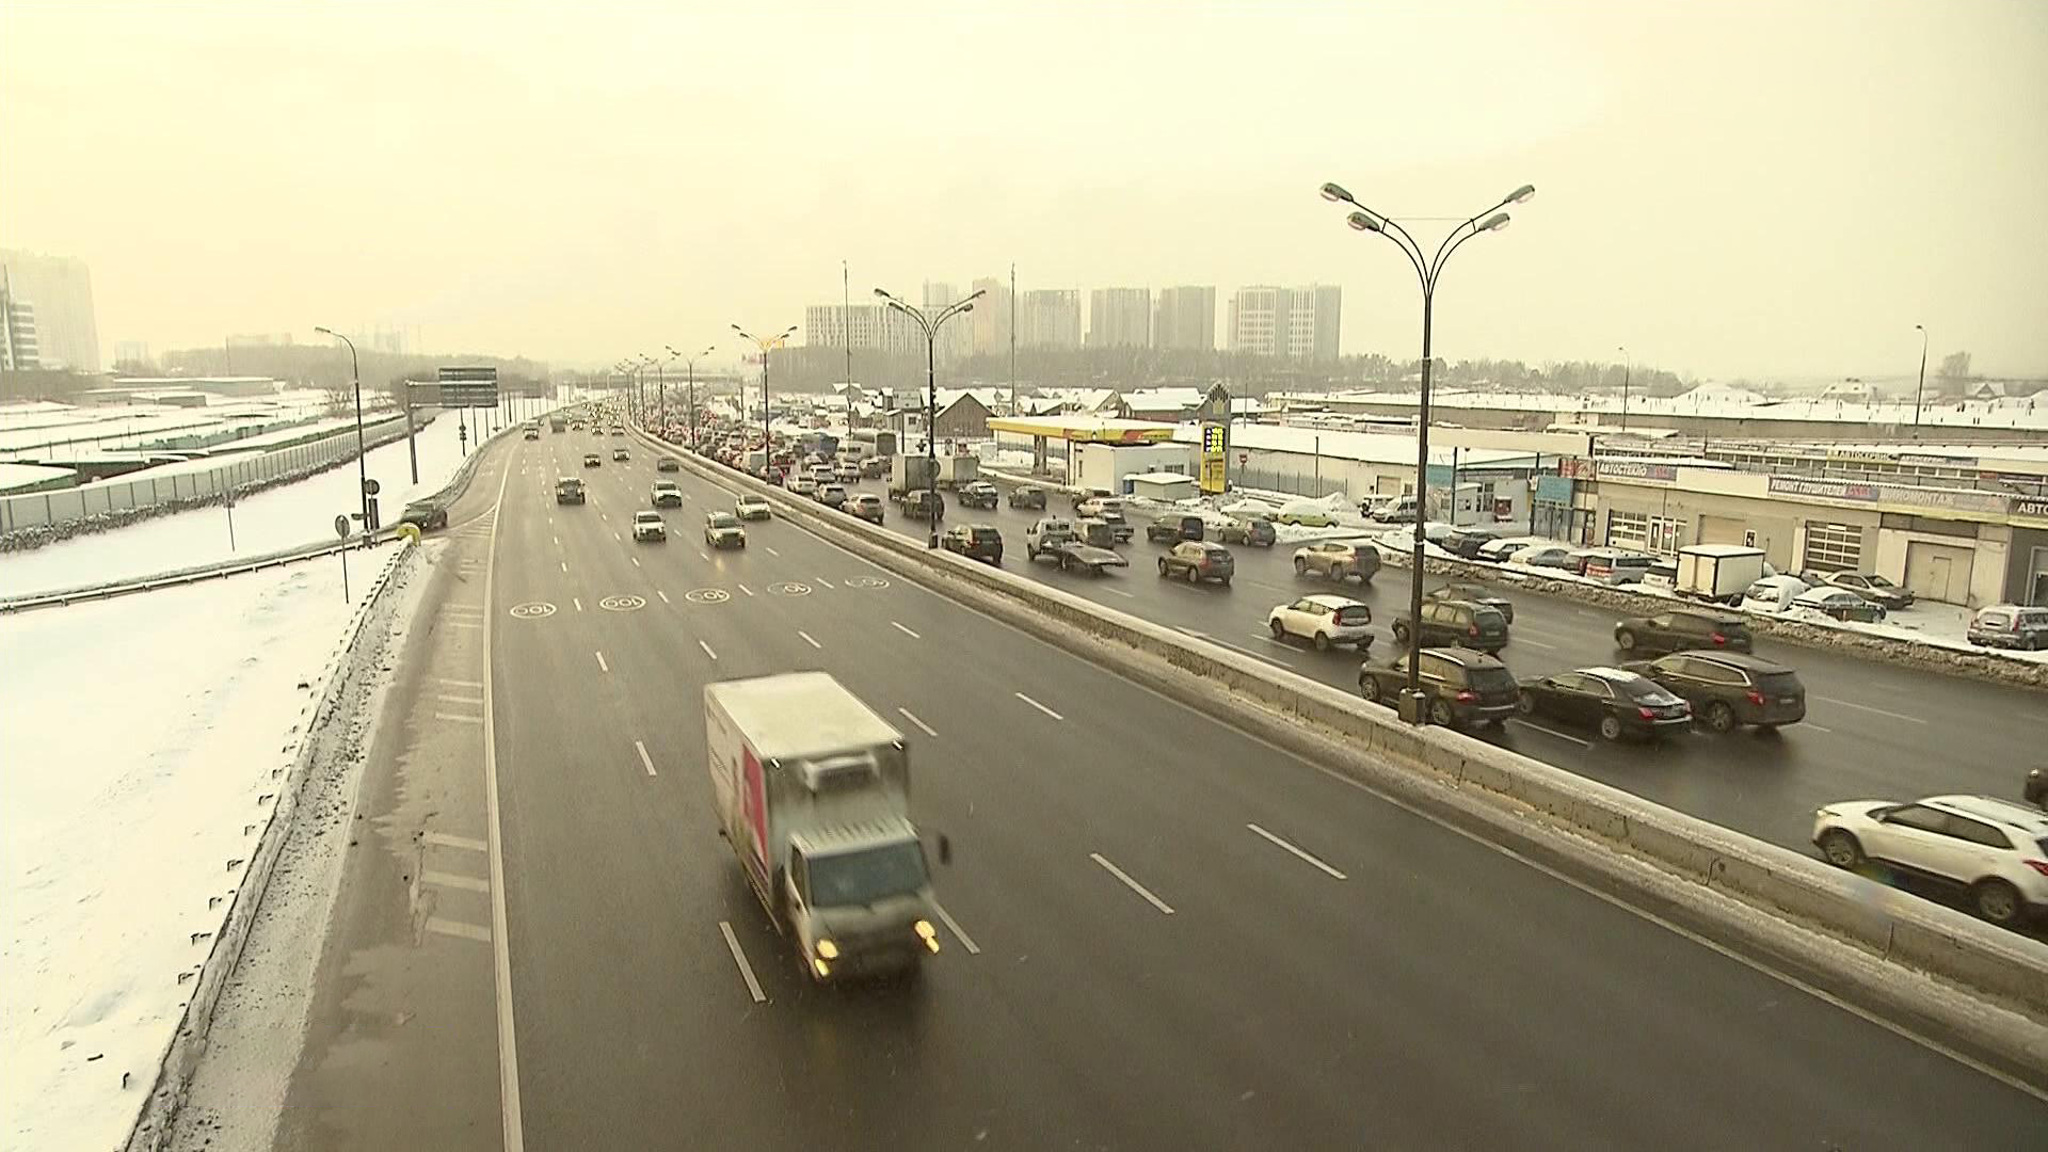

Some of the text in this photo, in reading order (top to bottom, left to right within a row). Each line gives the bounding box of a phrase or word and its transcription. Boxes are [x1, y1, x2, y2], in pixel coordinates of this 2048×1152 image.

[1599, 462, 1647, 477] АВТОСТЕКЛО
[1771, 479, 1798, 492] РЕМОНТ
[1880, 488, 1954, 506] ШИНОМОНТАЖ
[605, 598, 640, 608] 100
[515, 605, 551, 615] 100
